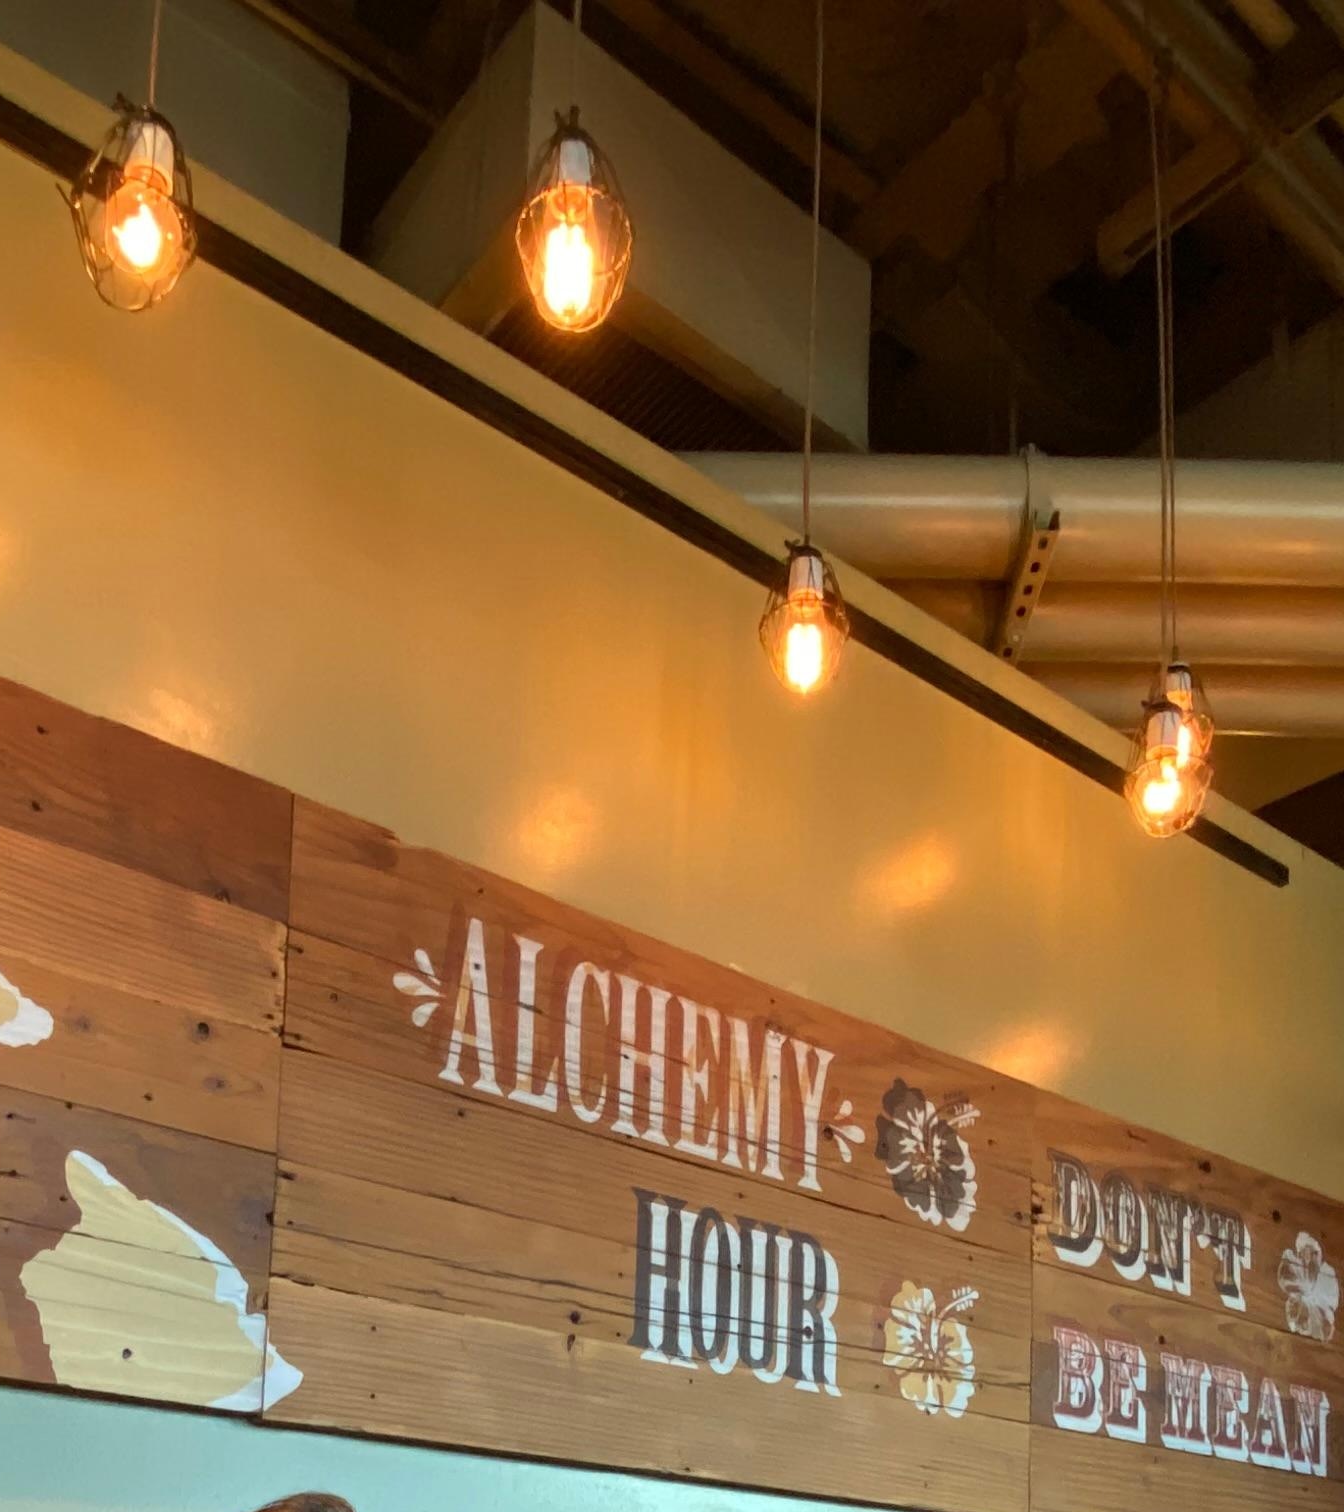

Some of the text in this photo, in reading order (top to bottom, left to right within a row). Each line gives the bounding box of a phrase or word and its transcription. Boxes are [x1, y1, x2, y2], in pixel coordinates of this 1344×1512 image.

[437, 914, 836, 1192] ALCHEMY
[630, 1187, 843, 1398] HOUR
[1047, 1148, 1251, 1312] DON'T
[1052, 1325, 1331, 1477] BE MEAN
